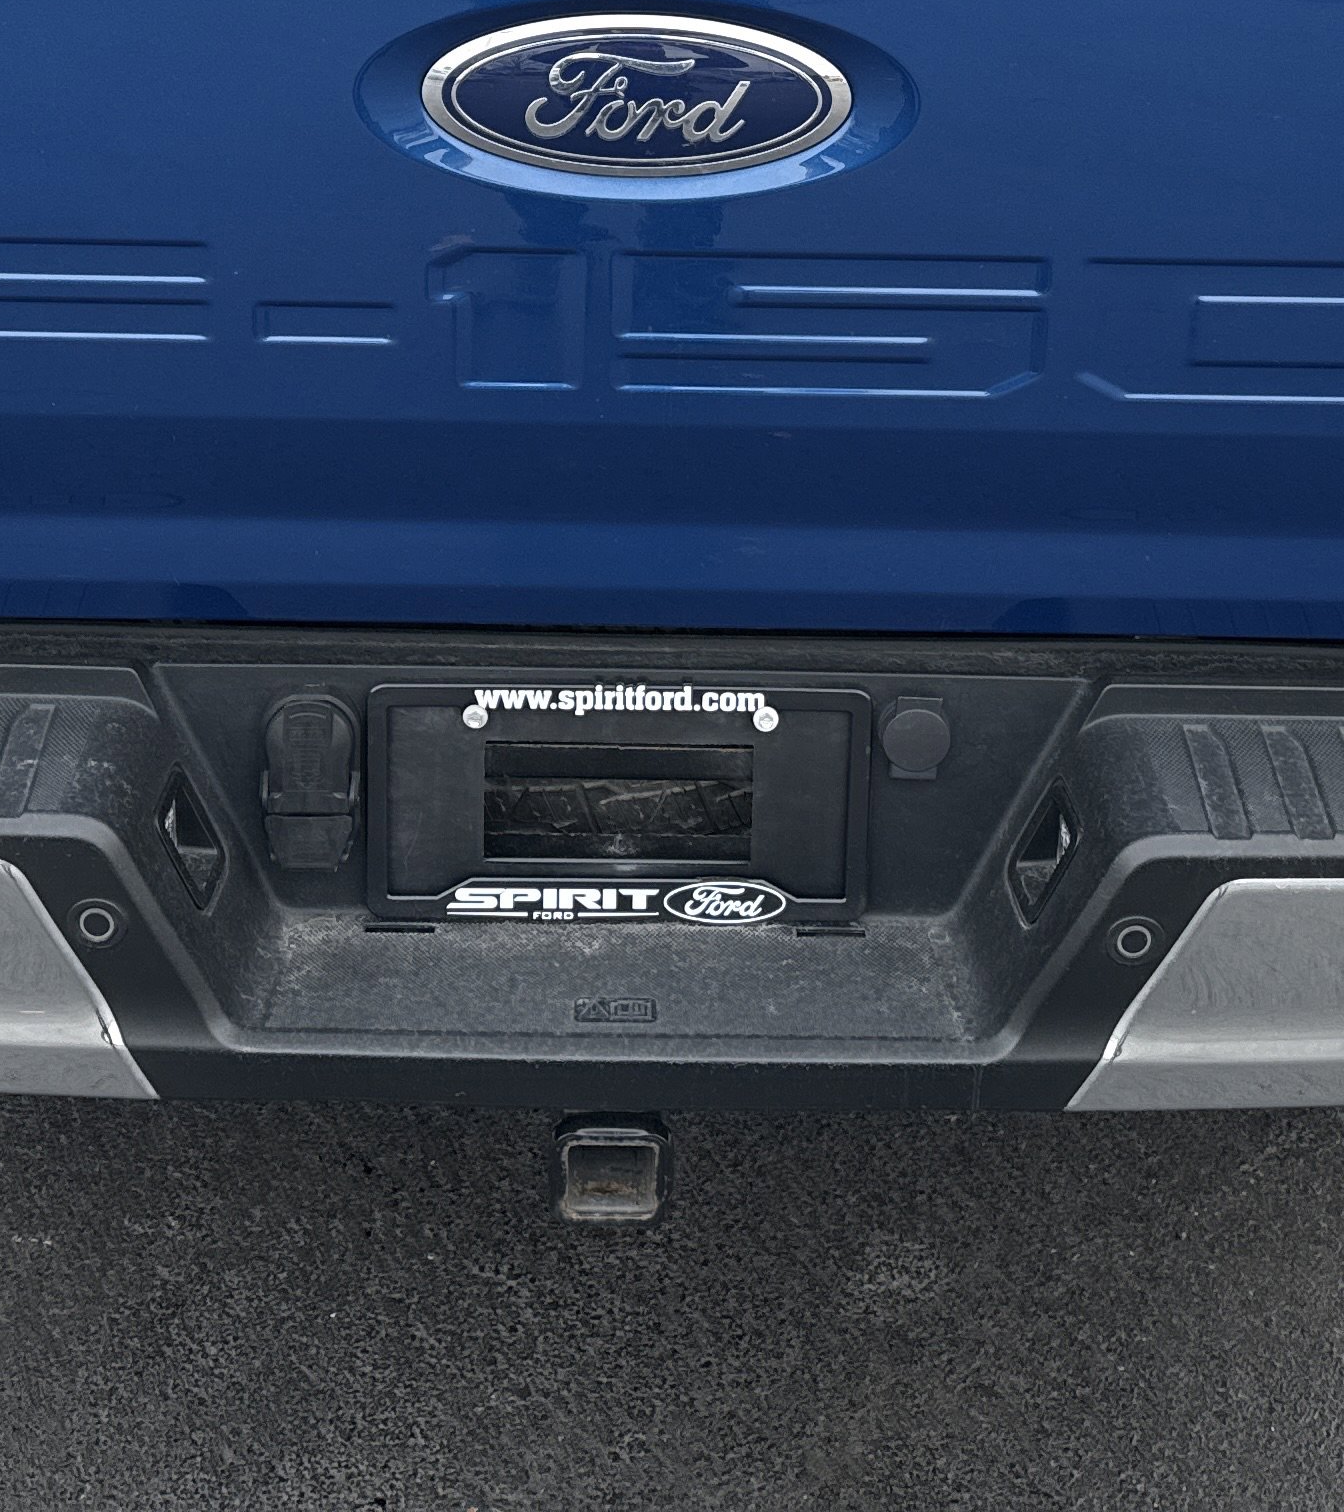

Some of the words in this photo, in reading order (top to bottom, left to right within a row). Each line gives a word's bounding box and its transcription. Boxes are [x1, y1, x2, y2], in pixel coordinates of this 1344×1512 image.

[524, 51, 751, 143] Ford
[474, 684, 766, 716] www.spiritford.com
[446, 887, 660, 910] SPIRIT
[684, 885, 764, 918] Ford
[532, 910, 574, 920] FORD
